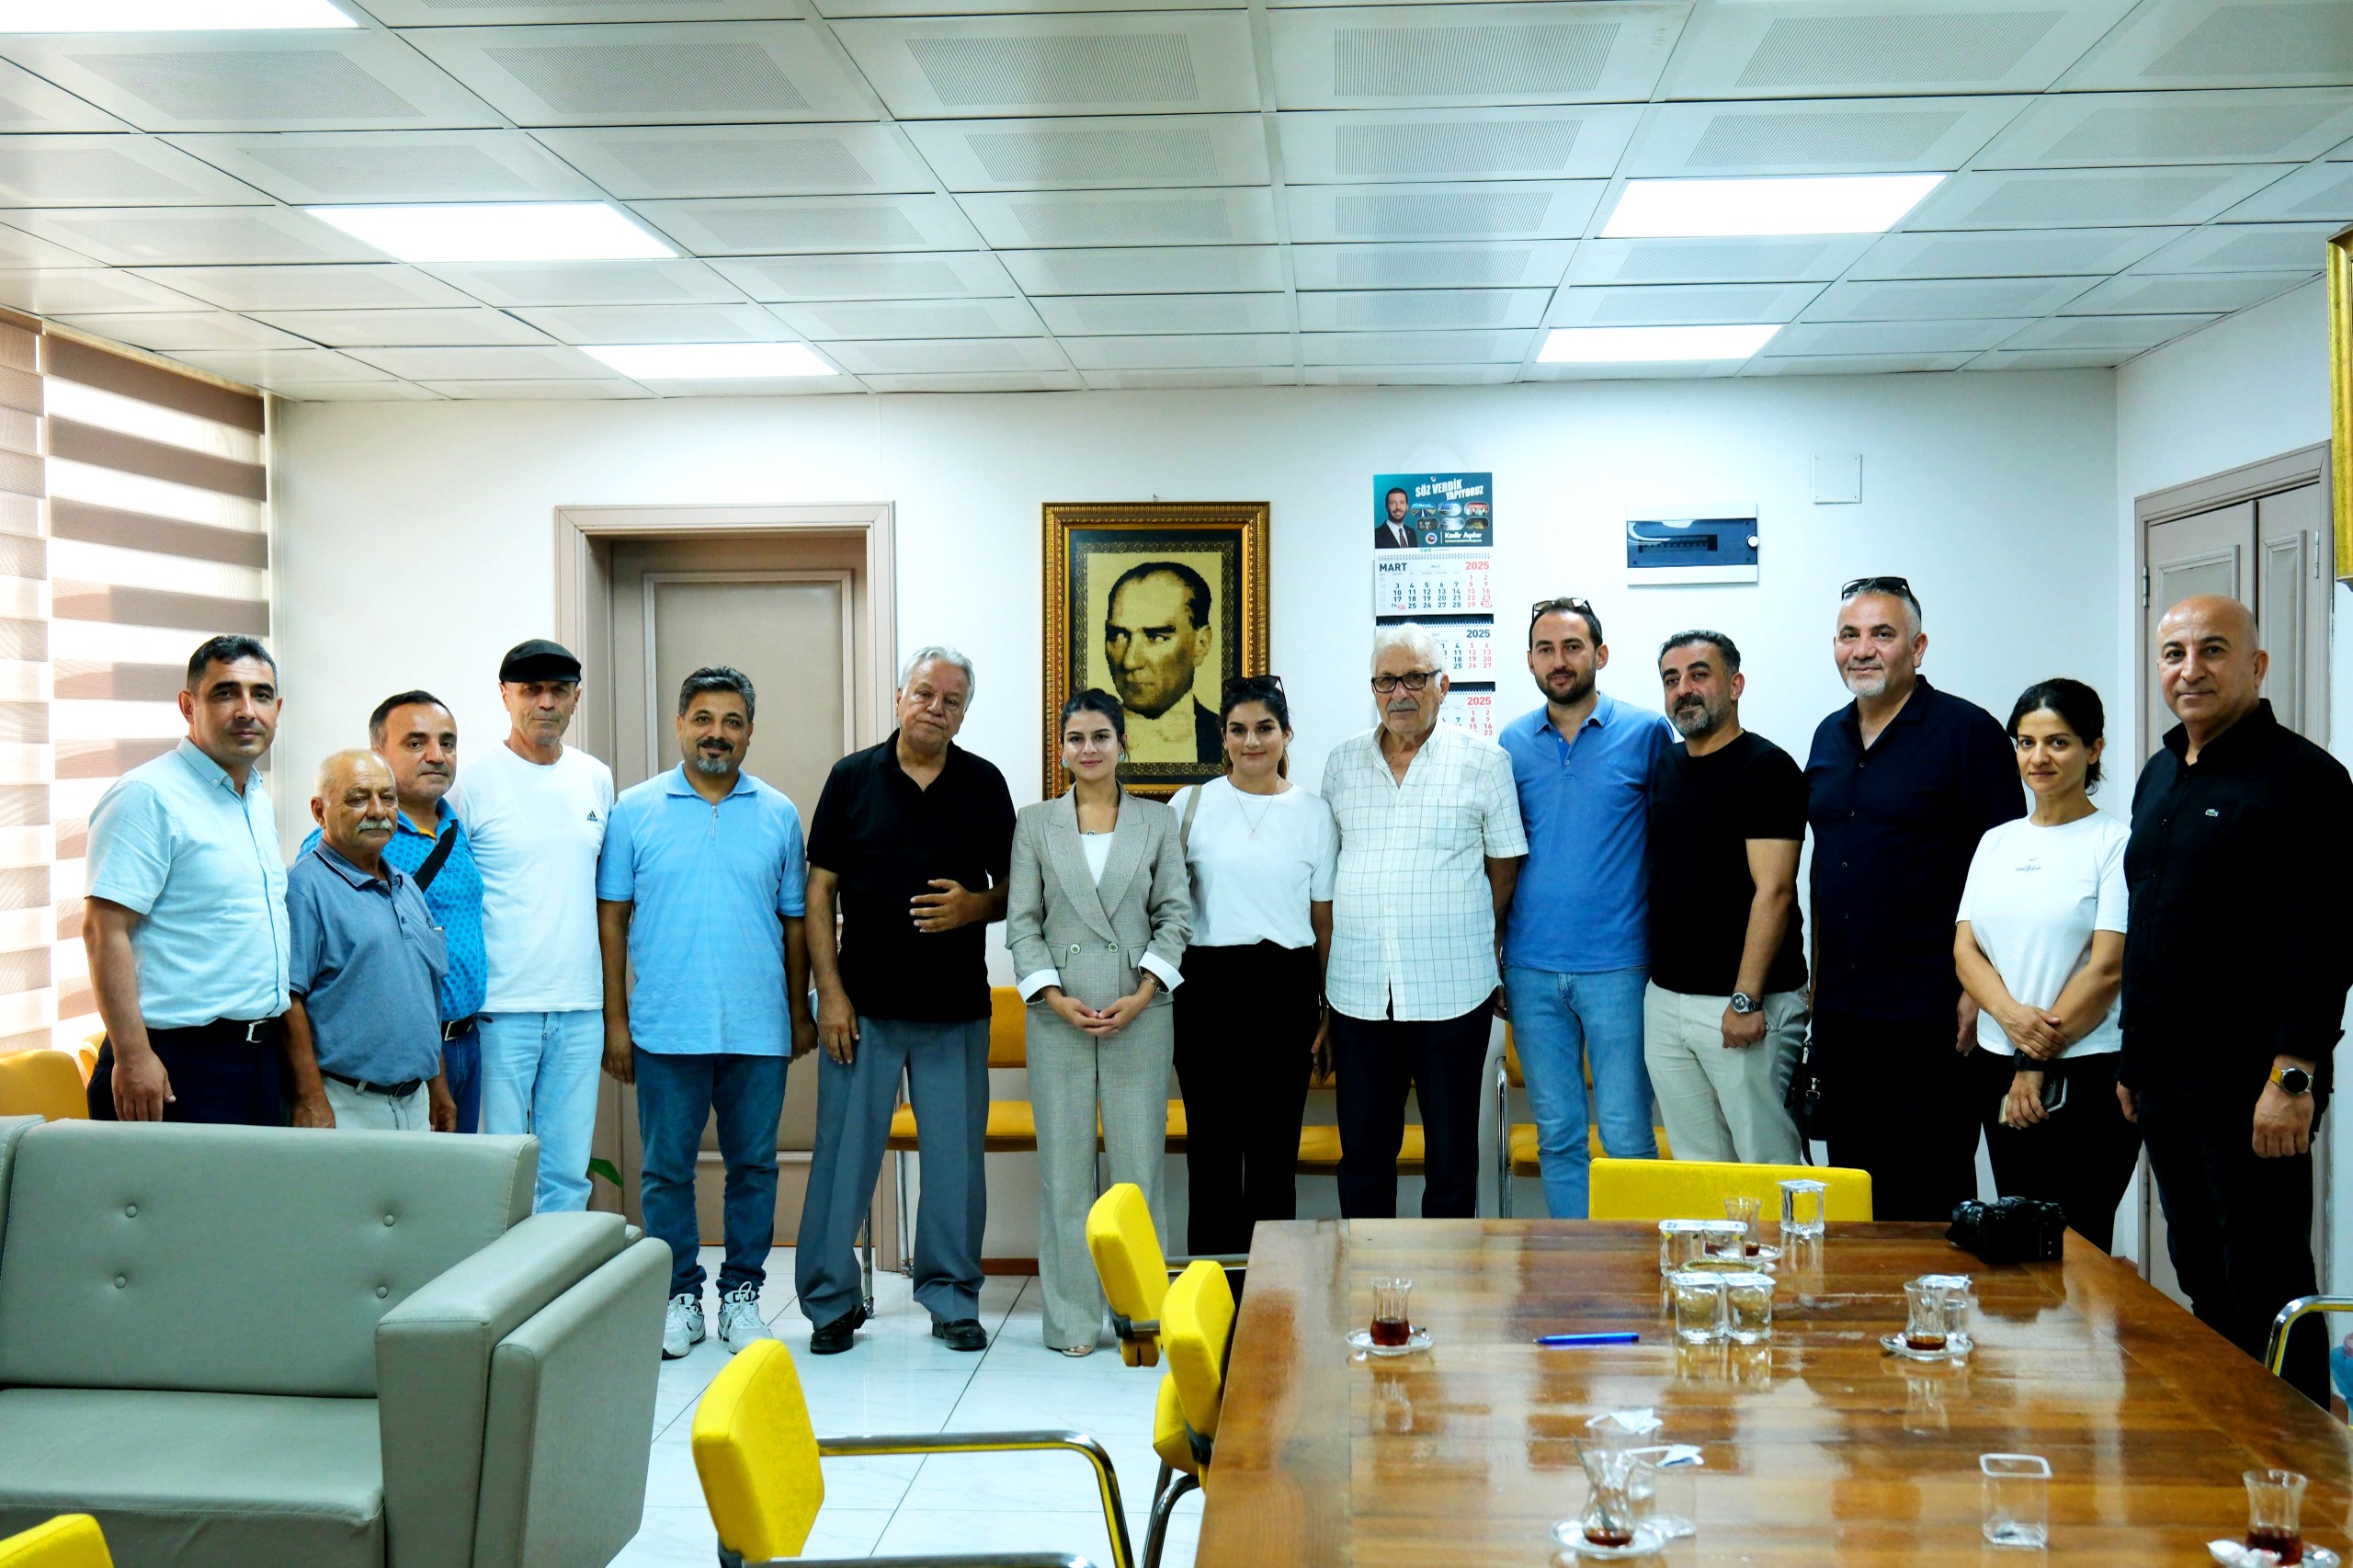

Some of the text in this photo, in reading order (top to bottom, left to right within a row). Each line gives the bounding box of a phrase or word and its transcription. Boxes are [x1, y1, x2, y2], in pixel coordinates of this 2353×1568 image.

[1415, 478, 1462, 497] SÖZ VERDİK
[1446, 485, 1483, 501] YAPIYORUZ
[1380, 562, 1489, 572] MART 2025
[1466, 630, 1490, 638] 2025
[1467, 697, 1492, 706] 2025
